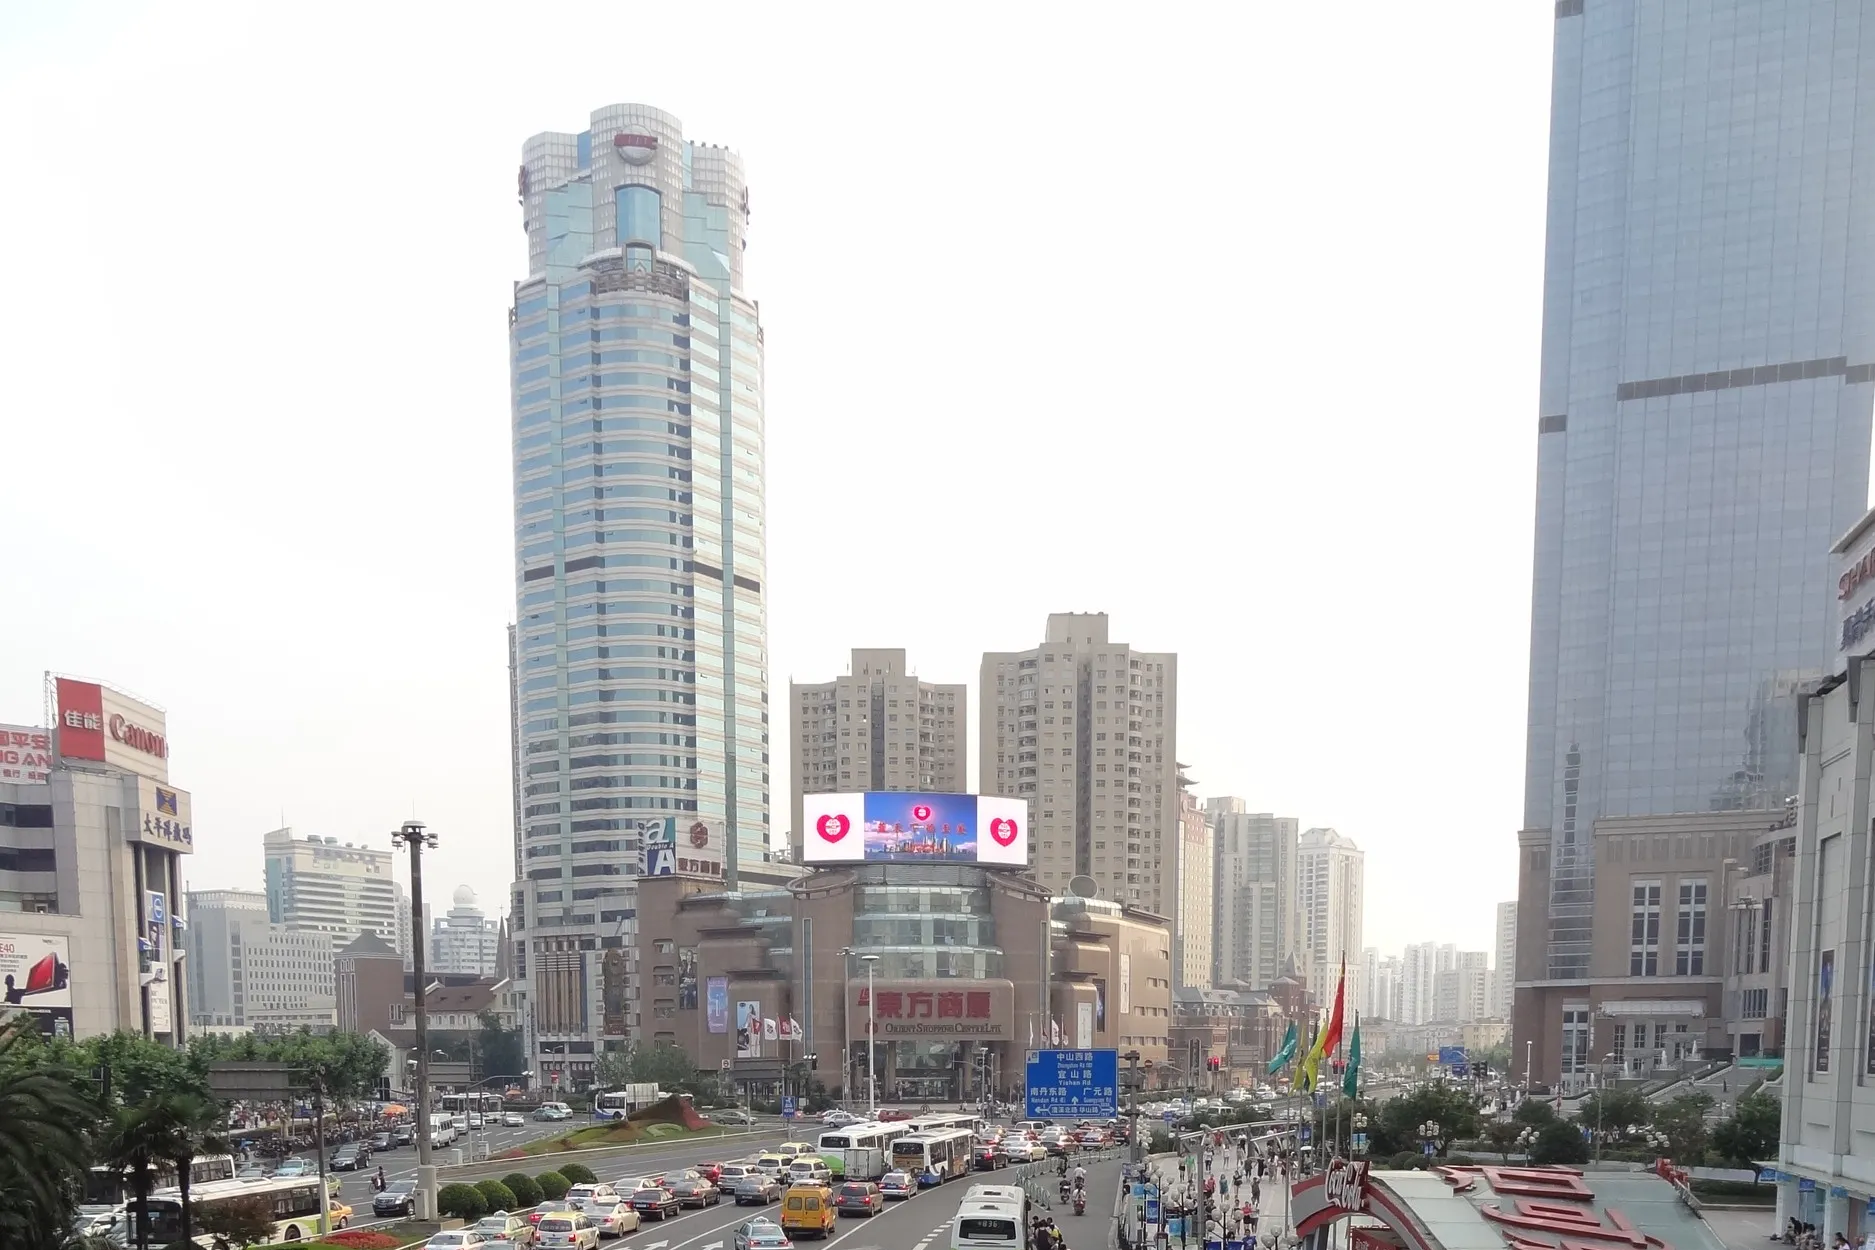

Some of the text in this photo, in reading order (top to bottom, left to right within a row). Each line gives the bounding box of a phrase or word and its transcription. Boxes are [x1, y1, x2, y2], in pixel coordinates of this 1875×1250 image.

[64, 709, 101, 731] 佳能
[109, 713, 167, 759] Canon
[144, 813, 192, 845] 太平洋数码
[1056, 1052, 1093, 1061] 中山西路
[1057, 1069, 1092, 1079] 宜山路
[1030, 1087, 1067, 1096] 南丹东路
[1083, 1087, 1113, 1096] 广元路
